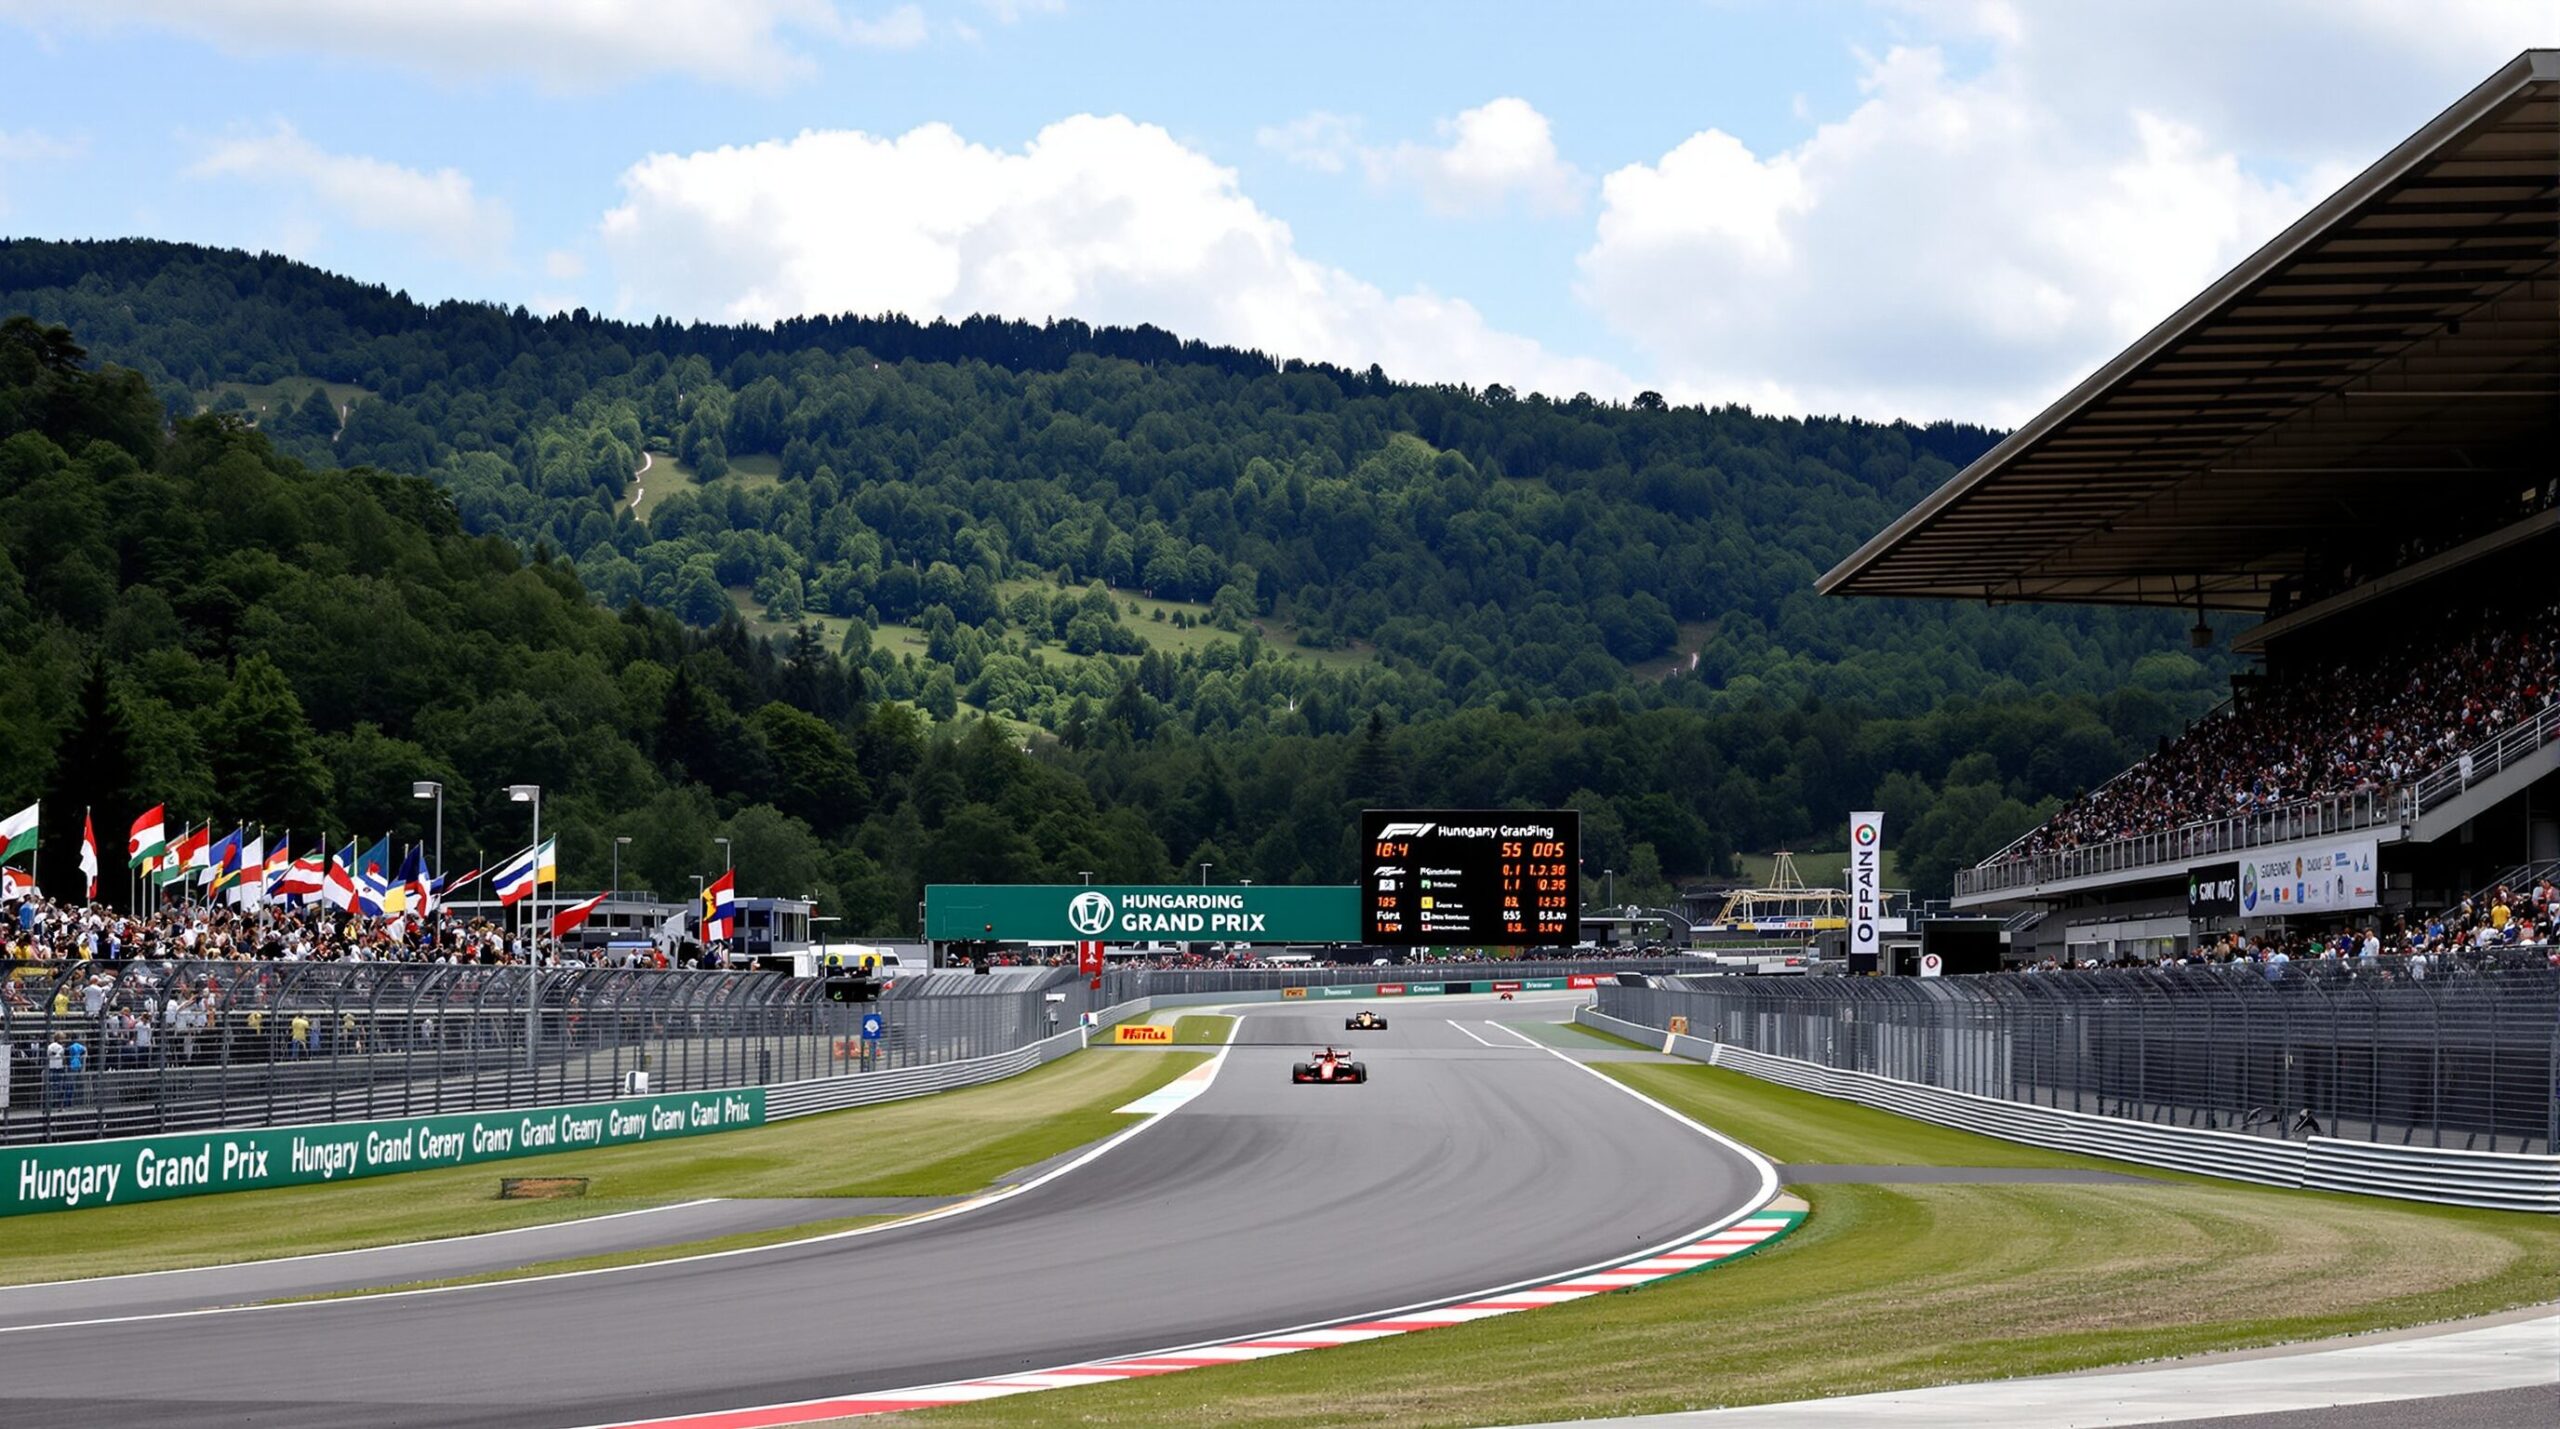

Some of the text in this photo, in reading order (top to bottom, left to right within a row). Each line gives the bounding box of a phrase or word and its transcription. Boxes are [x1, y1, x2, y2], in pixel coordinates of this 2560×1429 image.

[1122, 894, 1243, 909] HUNGARDING
[1122, 913, 1265, 931] GRAND PRIX
[292, 1136, 359, 1178] Hungary
[367, 1128, 412, 1164] Grand
[521, 1116, 556, 1147] Grand
[19, 1141, 269, 1205] Hungary Grand Prix
